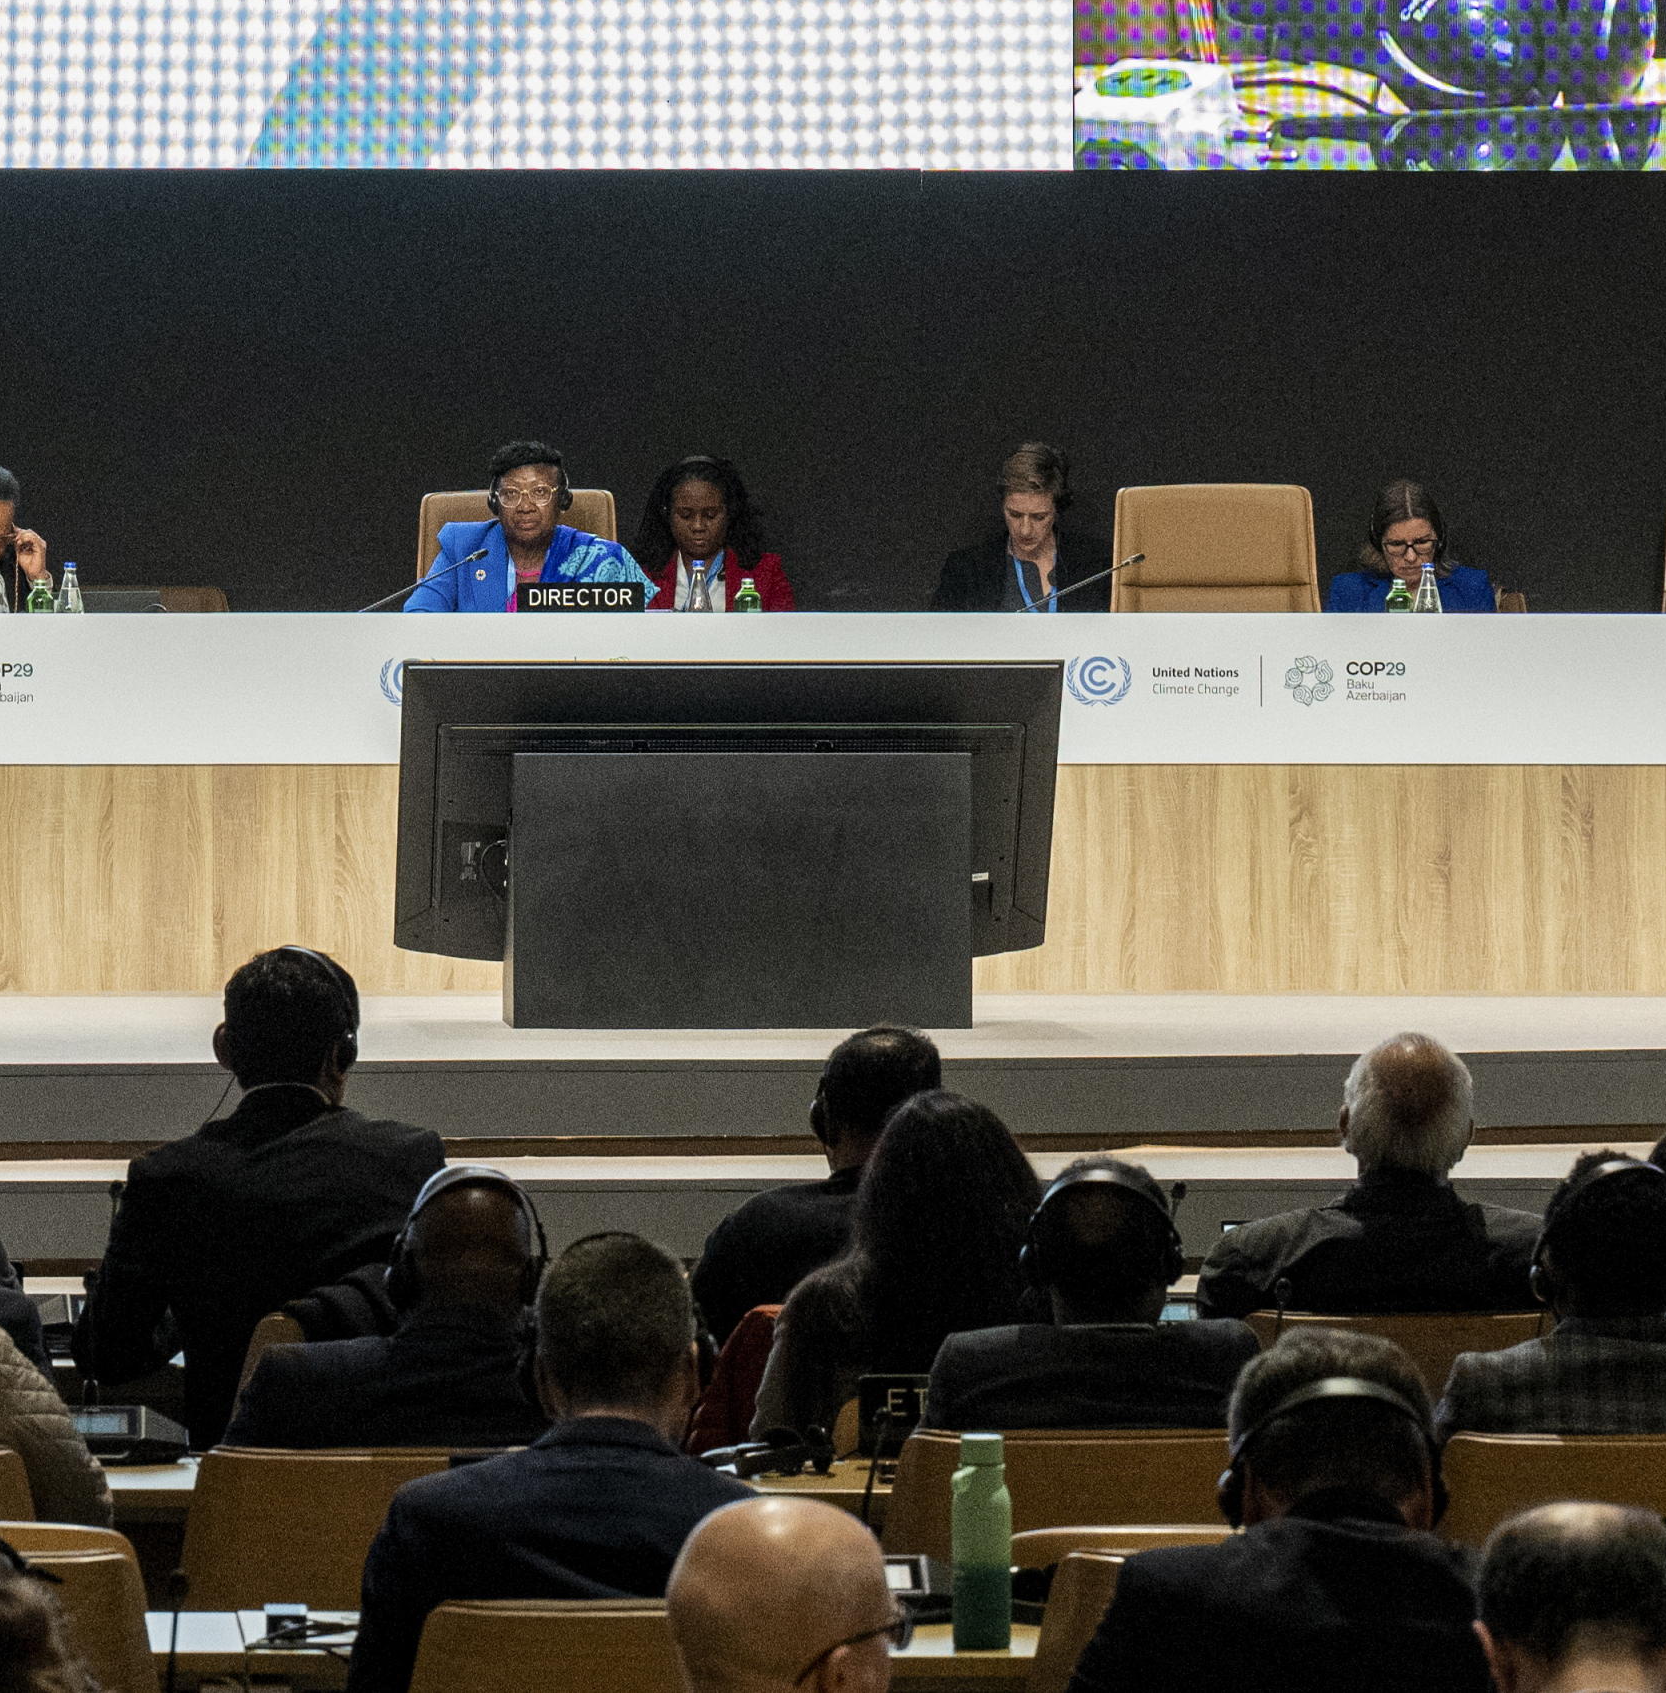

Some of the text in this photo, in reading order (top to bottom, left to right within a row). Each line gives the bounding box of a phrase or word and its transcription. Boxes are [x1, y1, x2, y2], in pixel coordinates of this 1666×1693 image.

[528, 588, 633, 606] DIRECTOR
[1152, 667, 1239, 678] United Nations
[1346, 661, 1406, 676] COP29
[1152, 684, 1240, 697] Climate Change
[1346, 679, 1375, 690] Baku
[1346, 690, 1407, 702] Azerbaijan
